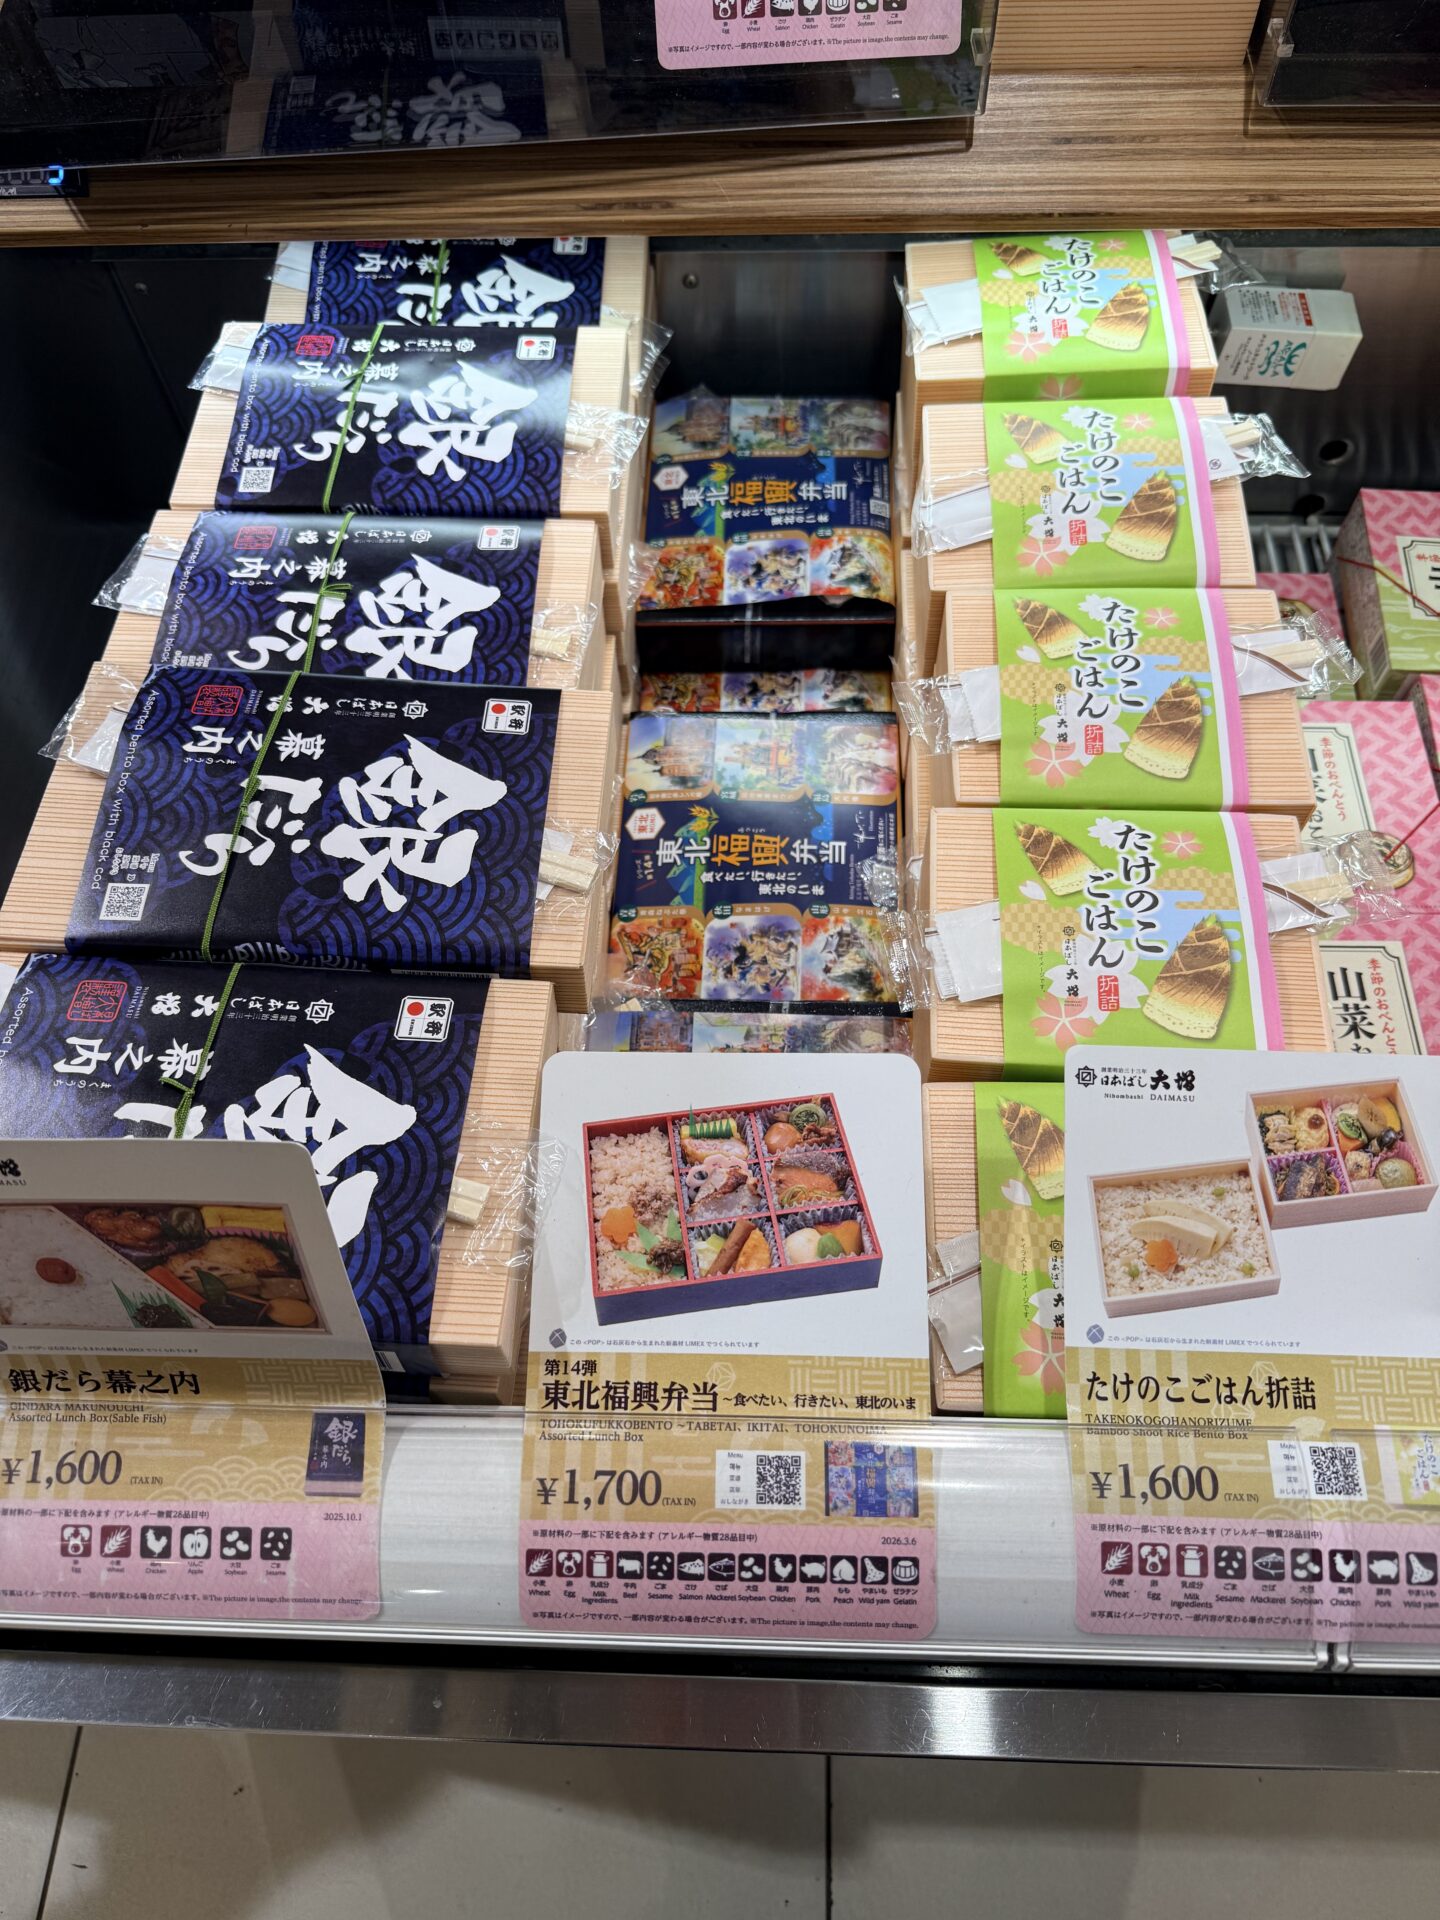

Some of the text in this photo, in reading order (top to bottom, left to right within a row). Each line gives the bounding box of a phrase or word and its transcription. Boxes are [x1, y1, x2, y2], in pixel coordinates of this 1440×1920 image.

[1064, 239, 1100, 305] たけのこ
[1042, 261, 1072, 315] ごはん
[293, 360, 538, 482] 銀だら
[230, 395, 253, 473] box with black cod
[1084, 411, 1123, 501] たけのこ
[1060, 444, 1091, 514] ごはん
[680, 479, 848, 509] 東北福興弁当
[228, 555, 347, 583] 幕之内
[160, 532, 208, 664] Assorted bento box with black
[228, 553, 501, 680] 銀だら
[1103, 601, 1144, 708] たけのこ
[1076, 639, 1109, 719] ごはん
[336, 697, 398, 712] 日本ばし
[508, 704, 526, 731] 駅弁
[1057, 718, 1068, 743] 大増
[181, 725, 326, 762] 幕之内
[1085, 726, 1103, 755] 折詰
[183, 757, 238, 765] まくのうち
[1320, 736, 1346, 822] 季節のおべんとう
[91, 689, 160, 890] Assorted bento box with black cod
[179, 733, 507, 912] 銀だら
[656, 833, 847, 866] 東北福興弁当
[700, 869, 803, 883] 食べたい、行きたい、
[758, 884, 825, 896] 東北のいま
[1114, 824, 1164, 954] たけのこ
[713, 905, 732, 916] 秋田
[810, 904, 829, 915] 山形
[1085, 871, 1124, 969] ごはん
[1064, 938, 1072, 966] 日本ばし
[1066, 968, 1079, 998] 大増
[1099, 977, 1119, 1010] 折詰
[126, 986, 142, 1019] DAIMASU
[151, 992, 301, 1018] 日本ばし 大増
[3, 987, 34, 1044] Assorted
[226, 1011, 298, 1023] 創業明治三十三年
[425, 1002, 447, 1037] 駅弁
[53, 1038, 215, 1081] 幕之内
[53, 1079, 112, 1089] まくのうち
[1100, 1069, 1195, 1091] 日本ばし 大増
[1104, 1092, 1195, 1102] Nihombashi DAIMASU
[1247, 1340, 1301, 1348] でつくられています
[543, 1358, 598, 1376] 第14弾
[8, 1369, 200, 1395] 銀だら幕之内
[541, 1379, 719, 1413] 東北福興弁当
[1086, 1371, 1317, 1411] たけのこごはん折詰
[10, 1402, 144, 1412] GINDARA MAKUNOUCHI
[9, 1413, 167, 1425] Assorted Lunch Box(Sable Fish)
[540, 1419, 673, 1431] TOHOKUFUKKOBENTO
[539, 1430, 645, 1442] Assorted Lunch Box
[1132, 1428, 1249, 1440] Shoot Rice Bento Box
[1, 1450, 164, 1490] ¥1,600 (TAX IN)
[536, 1469, 697, 1511] ¥1,700 (TAX IN)
[1090, 1463, 1260, 1505] ¥1,600 (TAX IN)
[323, 1512, 363, 1521] 2025.10.1
[533, 1529, 654, 1540] ※原材料の一部に下記を含みます
[881, 1536, 917, 1546] 2026.3.6
[623, 1582, 637, 1590] 牛肉
[1109, 1578, 1125, 1587] 小麦
[1223, 1583, 1238, 1591] ごま
[1261, 1584, 1277, 1592] さば
[528, 1589, 551, 1597] Wheat
[563, 1590, 576, 1599] Egg
[592, 1590, 607, 1598] Milk
[622, 1591, 638, 1599] Beef
[648, 1592, 673, 1600] Sesame
[678, 1593, 703, 1601] Salmon
[705, 1593, 737, 1602] Mackerel
[737, 1594, 766, 1603] Soybean
[769, 1595, 796, 1603] Chicken
[1104, 1589, 1130, 1599] Wheat
[1147, 1590, 1162, 1601] Egg
[1183, 1592, 1200, 1600] Milk
[1215, 1594, 1246, 1603] Sesame
[224, 1595, 336, 1606] picture contents may
[805, 1596, 821, 1604] Pork
[833, 1596, 854, 1604] Peach
[858, 1597, 876, 1605] Wild
[893, 1597, 917, 1606] Gelatin
[1250, 1596, 1287, 1605] Mackerel
[1290, 1597, 1324, 1606] Soybean
[1330, 1598, 1361, 1607] Chicken
[1374, 1600, 1392, 1608] Pork
[1403, 1600, 1423, 1609] Wild
[772, 1619, 797, 1628] picture
[843, 1621, 874, 1629] contents
[875, 1622, 890, 1630] may
[891, 1622, 919, 1630] change.
